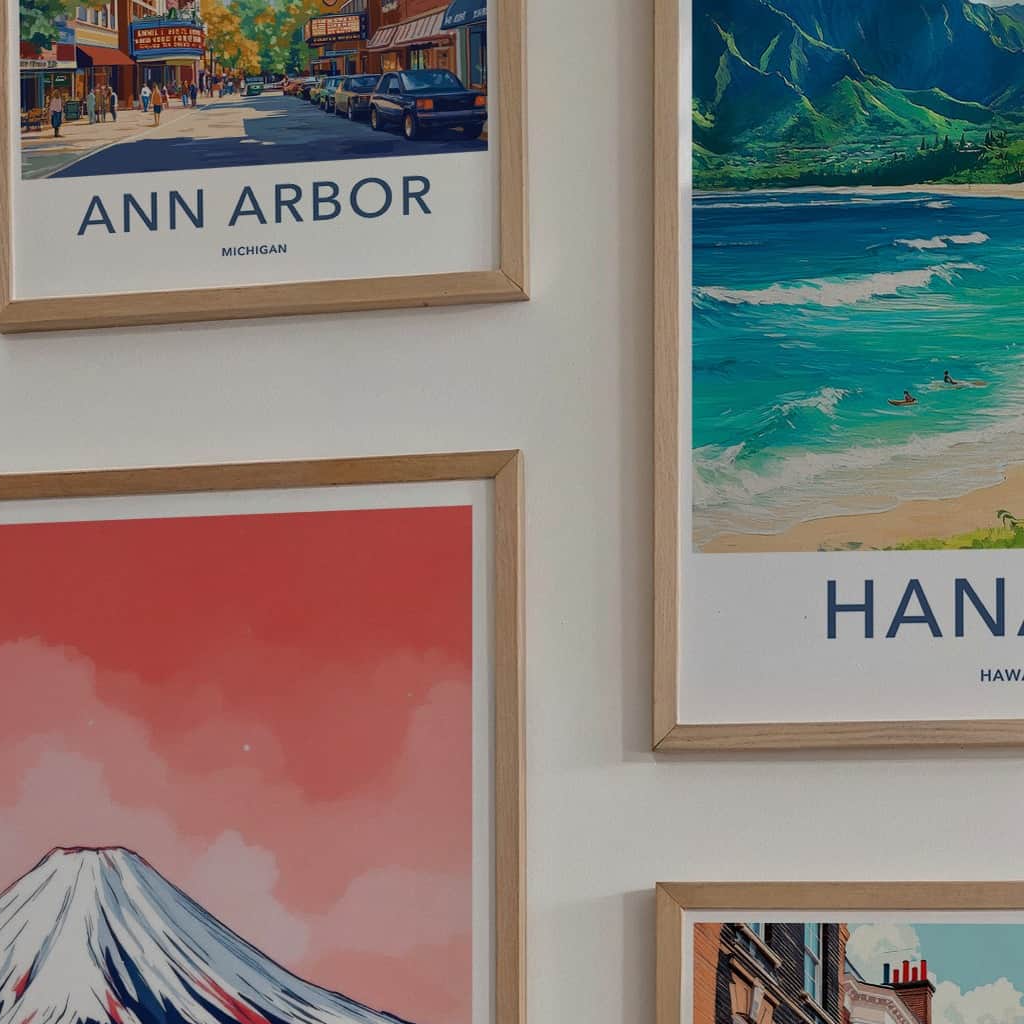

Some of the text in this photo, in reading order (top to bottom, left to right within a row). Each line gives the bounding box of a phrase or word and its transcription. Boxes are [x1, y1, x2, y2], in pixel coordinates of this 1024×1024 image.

[77, 175, 432, 236] ANN ARBOR
[221, 243, 287, 257] MICHIGAN
[826, 577, 1024, 640] HAN
[980, 668, 1024, 682] HAW
